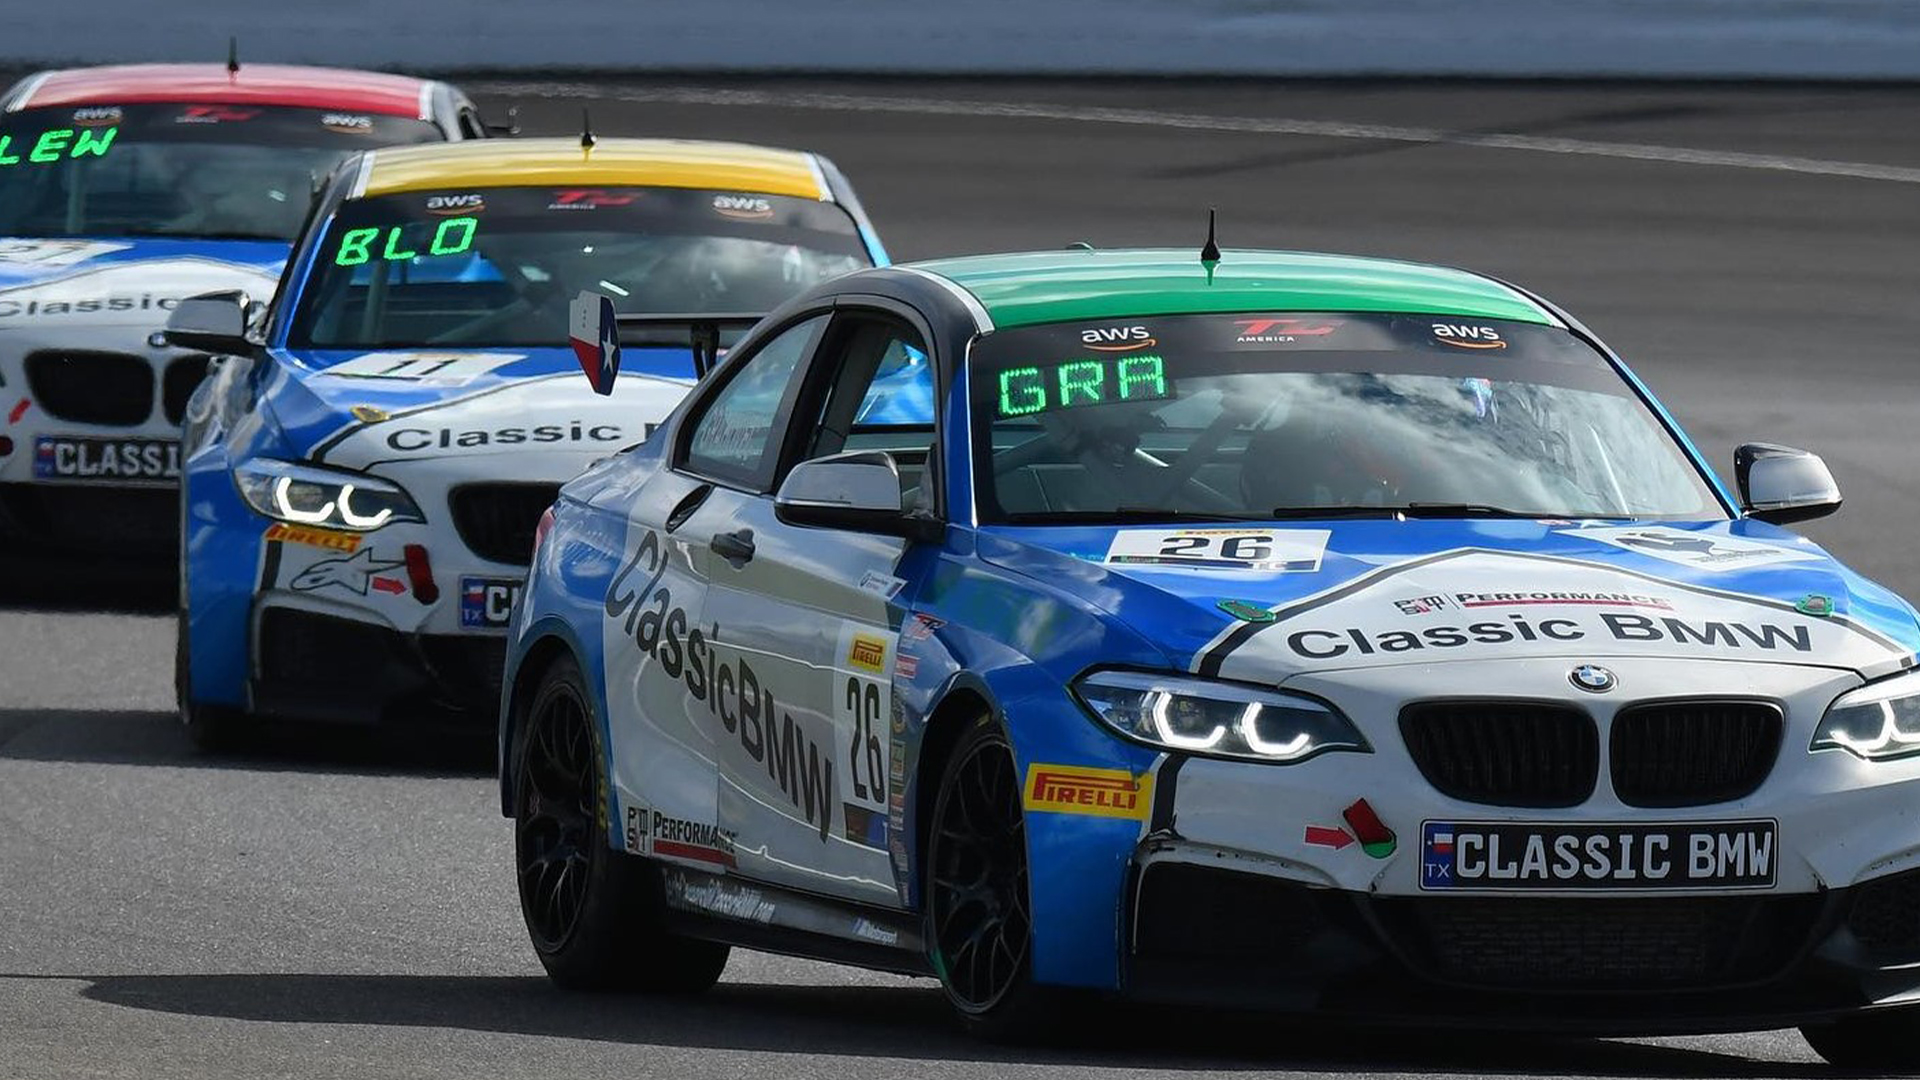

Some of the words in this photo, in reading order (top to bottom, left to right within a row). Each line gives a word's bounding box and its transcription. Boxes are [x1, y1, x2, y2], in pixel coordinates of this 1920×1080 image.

[428, 194, 483, 210] aws
[713, 195, 773, 211] aws
[336, 217, 478, 265] BLO
[0, 293, 180, 317] Classic
[1082, 324, 1151, 343] aws
[1237, 335, 1296, 343] AMERICA
[1432, 323, 1500, 341] aws
[378, 359, 460, 376] 11
[999, 355, 1167, 417] GRA
[387, 420, 622, 452] Classic
[1160, 536, 1274, 560] 26
[1456, 592, 1670, 606] PERFORMANCE
[463, 608, 482, 623] TX
[1287, 613, 1585, 659] Classic
[1599, 612, 1811, 653] BMW
[852, 640, 884, 666] PIRELLI
[604, 529, 833, 844] ClassicBMW
[847, 676, 885, 805] 26
[1032, 772, 1141, 810] PIRELLI
[1456, 833, 1672, 880] CLASSIC
[1687, 831, 1773, 879] BMW
[1425, 864, 1450, 878] TX
